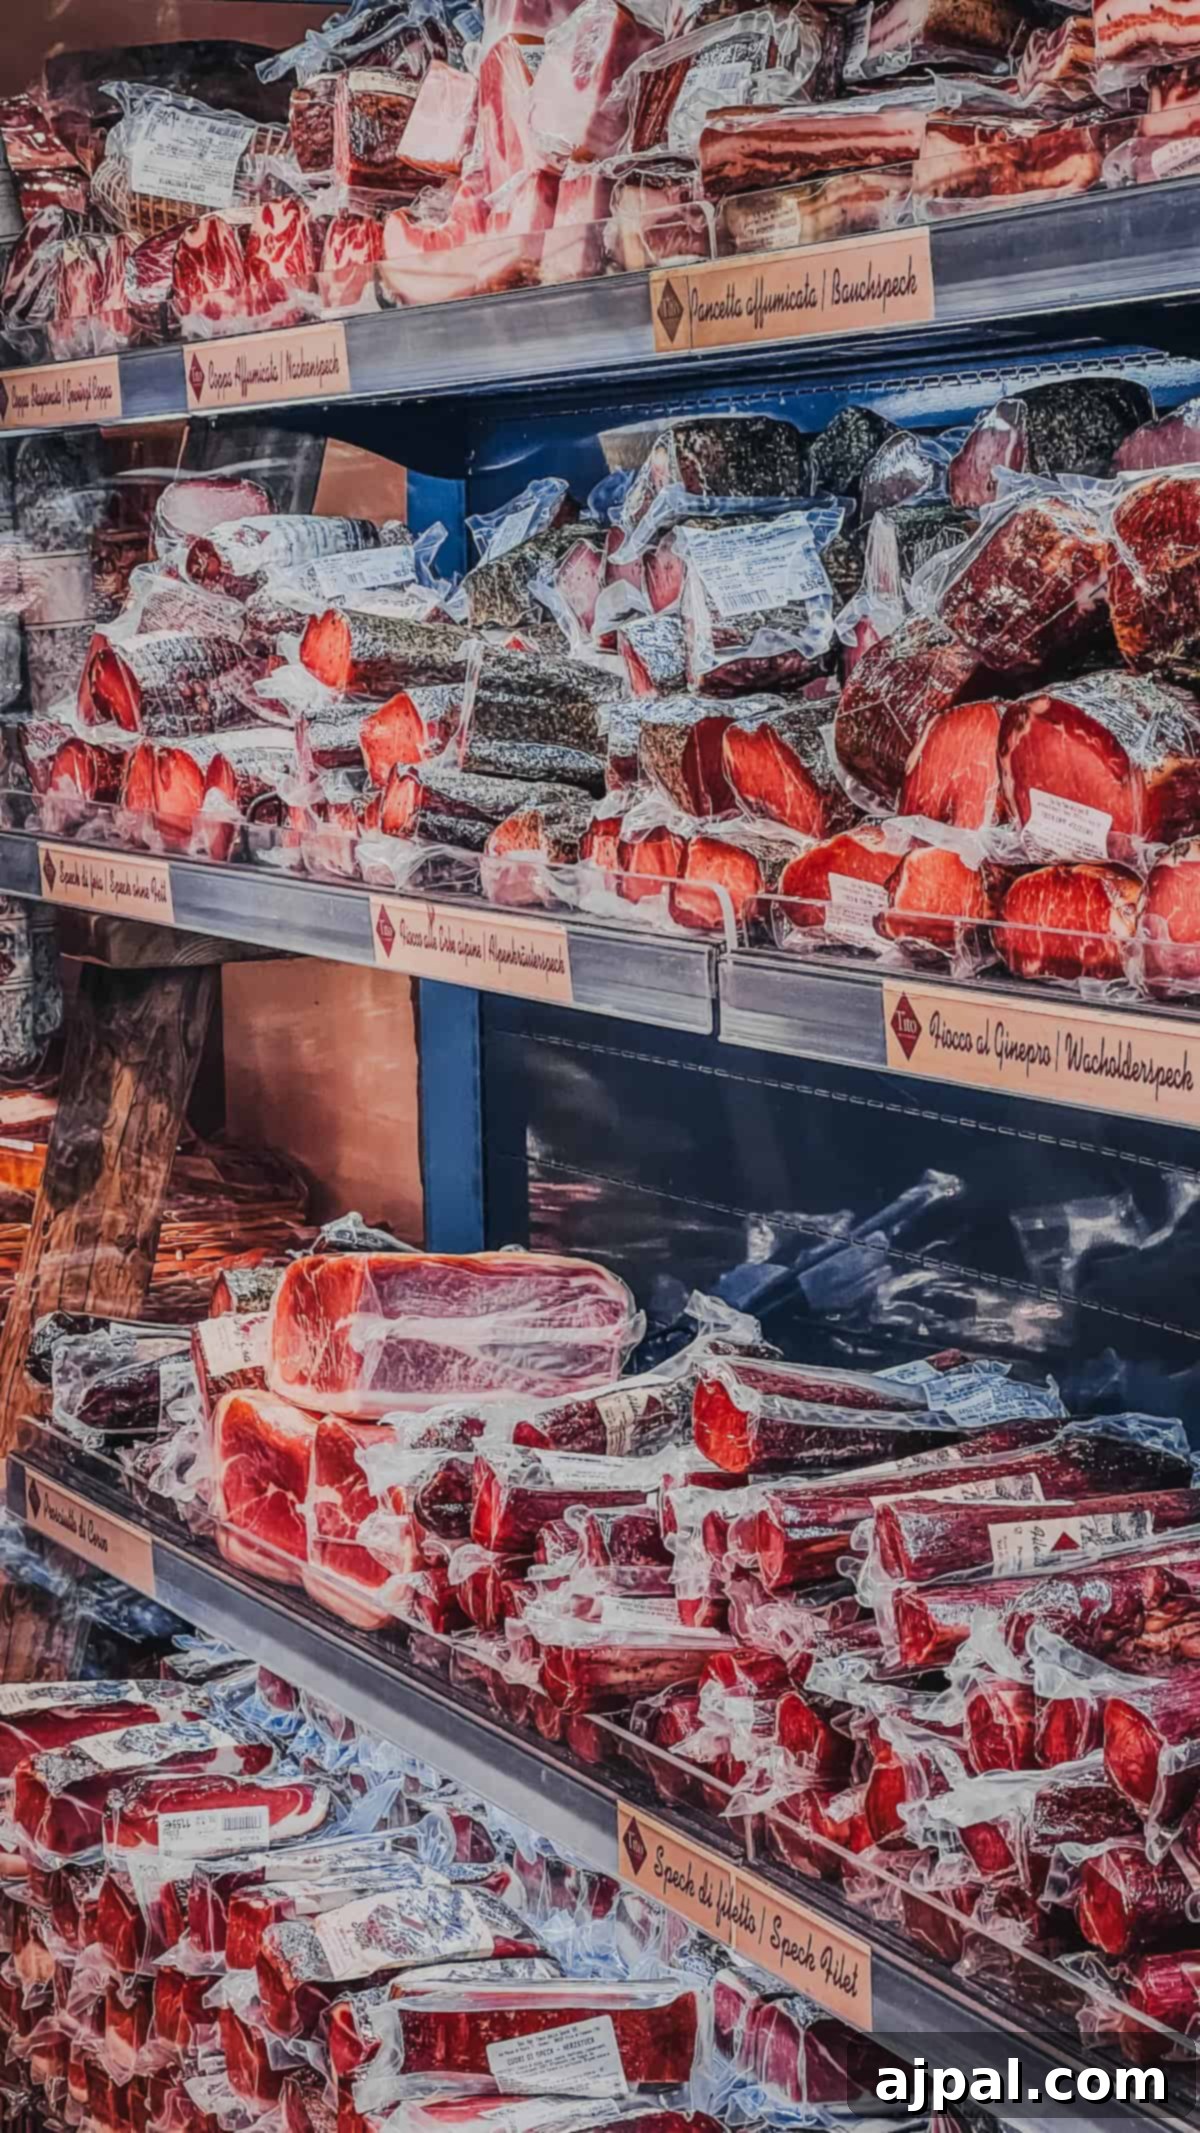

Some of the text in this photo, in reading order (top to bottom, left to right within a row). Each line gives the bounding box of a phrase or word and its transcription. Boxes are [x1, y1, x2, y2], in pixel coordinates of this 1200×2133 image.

[690, 286, 742, 323] Pancetta
[746, 272, 817, 330] affumicata
[831, 255, 918, 314] Bauchspeck
[234, 351, 279, 398] Affumicata
[929, 1010, 973, 1054] Fiocco
[976, 1018, 991, 1056] al
[994, 1021, 1051, 1079] Ginepro
[1064, 1032, 1194, 1102] Wacholderspeck
[654, 1845, 696, 1895] Speck
[698, 1871, 714, 1909] di
[716, 1884, 757, 1936] filetto
[769, 1915, 816, 1968] Speck
[820, 1946, 858, 1997] Filet
